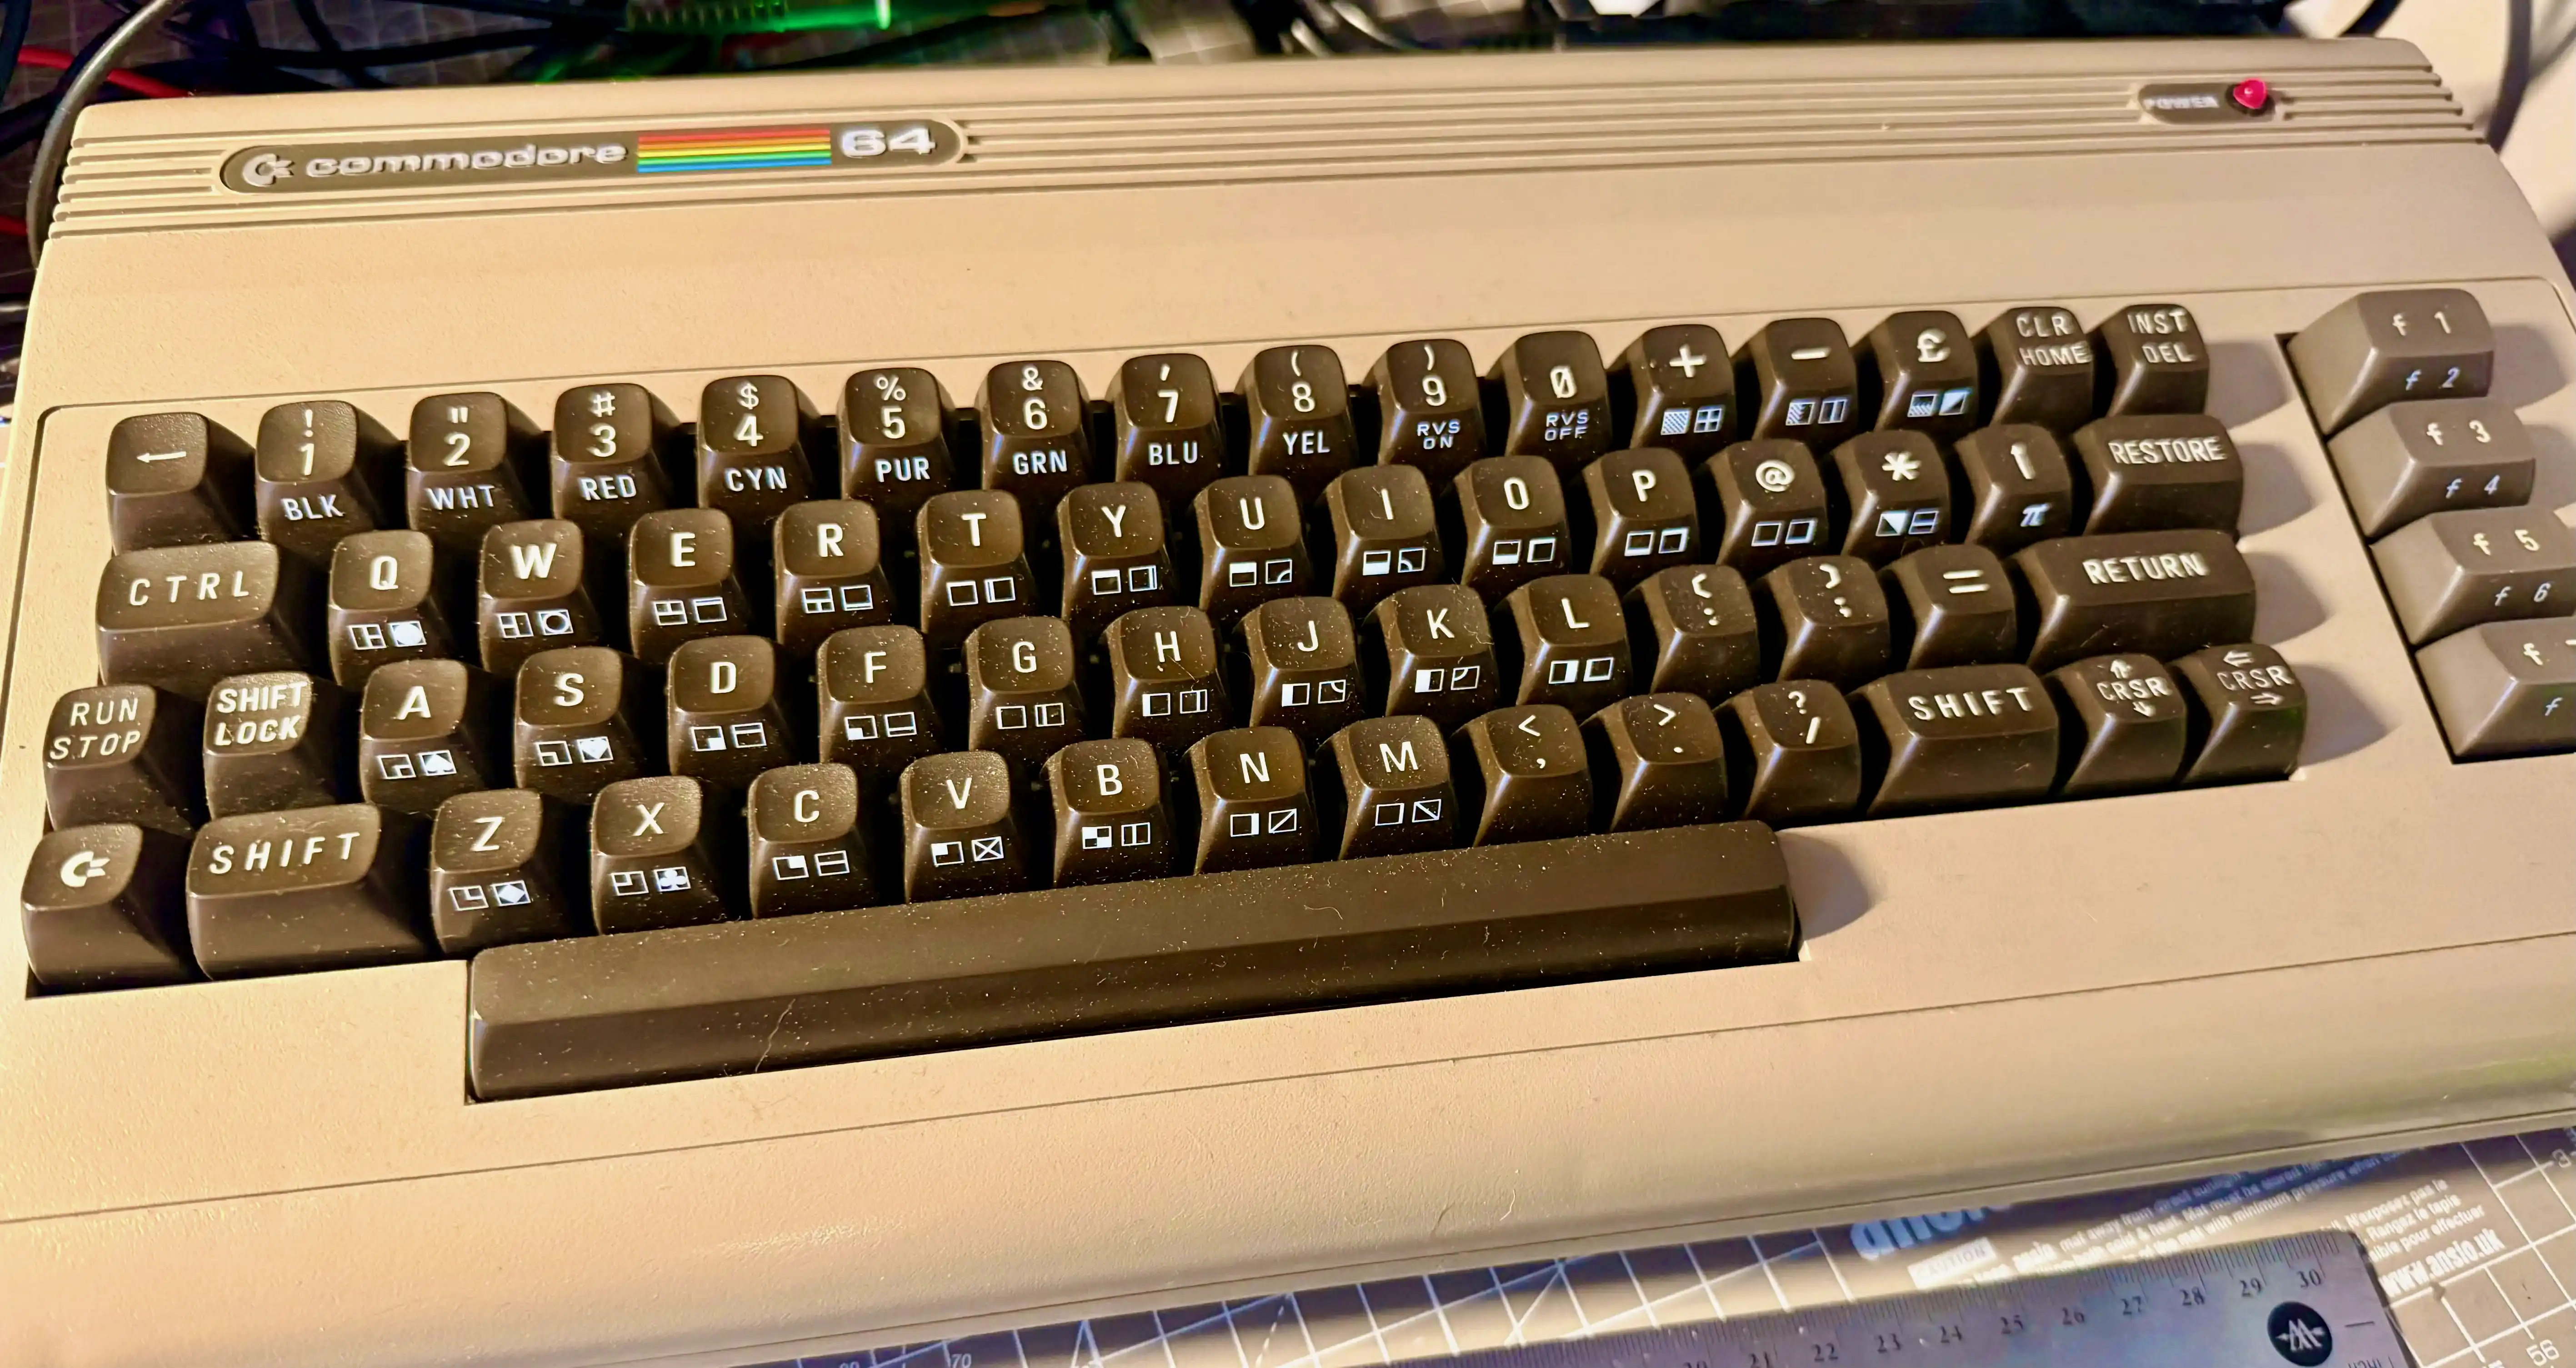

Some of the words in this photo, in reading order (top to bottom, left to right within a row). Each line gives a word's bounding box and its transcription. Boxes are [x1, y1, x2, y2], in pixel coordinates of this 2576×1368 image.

[2143, 95, 2220, 110] POWER
[306, 145, 625, 177] commodore
[841, 127, 935, 157] 64
[2016, 313, 2075, 337] CLR
[2128, 310, 2185, 333] INST
[2393, 315, 2406, 335] f
[2435, 312, 2450, 333] 1
[1425, 345, 1434, 370] )
[1917, 331, 1947, 362] £
[2020, 343, 2089, 365] HOME
[2141, 341, 2197, 363] DEL
[1291, 352, 1300, 376] (
[1670, 346, 1706, 377] +
[876, 376, 906, 400] %
[1023, 367, 1043, 390] &
[1423, 377, 1446, 406] 9
[2406, 370, 2421, 390] f
[2442, 367, 2460, 387] 2
[593, 392, 615, 417] #
[739, 383, 759, 409] $
[1158, 390, 1178, 422] 7
[1292, 383, 1315, 412] 8
[305, 409, 313, 437] !
[882, 407, 905, 439] 5
[1024, 398, 1047, 429] 6
[1546, 412, 1588, 427] RVS
[590, 424, 616, 457] 3
[735, 414, 763, 446] 4
[1417, 421, 1460, 436] RVS
[1424, 435, 1453, 449] ON
[1545, 426, 1587, 440] OFF
[2427, 423, 2442, 445] f
[2470, 421, 2491, 442] 3
[445, 432, 470, 466] 2
[1149, 442, 1197, 465] BLU
[1283, 431, 1330, 455] YEL
[2109, 437, 2224, 464] RESTORE
[301, 443, 314, 475] 1
[875, 458, 930, 482] PUR
[1013, 450, 1067, 474] GRN
[579, 475, 636, 500] RED
[725, 467, 787, 491] CYN
[1632, 470, 1656, 501] P
[1756, 461, 1794, 491] @
[2446, 479, 2462, 498] f
[2485, 475, 2500, 494] 4
[281, 494, 343, 520] BLK
[425, 485, 495, 509] WHT
[1381, 489, 1393, 519] I
[1504, 478, 1529, 509] O
[1101, 505, 1125, 537] Y
[1240, 497, 1264, 529] U
[818, 524, 843, 557] R
[961, 513, 986, 546] T
[2474, 534, 2490, 555] f
[2515, 530, 2539, 550] 5
[511, 543, 556, 579] W
[672, 532, 695, 567] E
[371, 556, 398, 590] Q
[1943, 570, 1988, 593] =
[2083, 554, 2207, 584] RETURN
[130, 570, 249, 605] CTRL
[2495, 586, 2511, 605] f
[2534, 583, 2551, 601] 6
[1427, 608, 1454, 639] K
[1561, 599, 1589, 628] L
[1155, 631, 1181, 662] H
[1298, 621, 1318, 651] J
[864, 651, 886, 683] F
[1013, 641, 1036, 673] G
[2524, 643, 2542, 665] f
[555, 673, 584, 706] S
[711, 662, 736, 693] D
[2097, 677, 2169, 700] CRSR
[2217, 666, 2291, 690] CRSR
[71, 697, 138, 726] RUN
[217, 681, 307, 714] SHIFT
[397, 686, 430, 719] A
[1789, 691, 1806, 714] ?
[1909, 688, 2031, 719] SHIFT
[2545, 698, 2562, 715] f
[1519, 715, 1540, 736] <
[1654, 704, 1676, 725] >
[50, 730, 140, 759] STOP
[215, 716, 301, 746] LOCK
[1806, 717, 1820, 744] /
[1240, 752, 1270, 783] N
[1380, 741, 1418, 772] M
[1537, 759, 1546, 769] ,
[946, 778, 972, 809] V
[1097, 764, 1122, 795] B
[633, 803, 665, 836] X
[795, 790, 819, 822] C
[471, 816, 505, 851] Z
[210, 832, 360, 874] SHIFT
[2378, 1227, 2506, 1298] www.ansio.uk
[2239, 1277, 2263, 1297] 29
[2297, 1268, 2323, 1288] 30
[2181, 1286, 2206, 1306] 28
[2061, 1307, 2086, 1325] 26
[1940, 1325, 1963, 1343] 24
[1811, 1343, 1839, 1362] 22
[2526, 1339, 2560, 1367] 56
